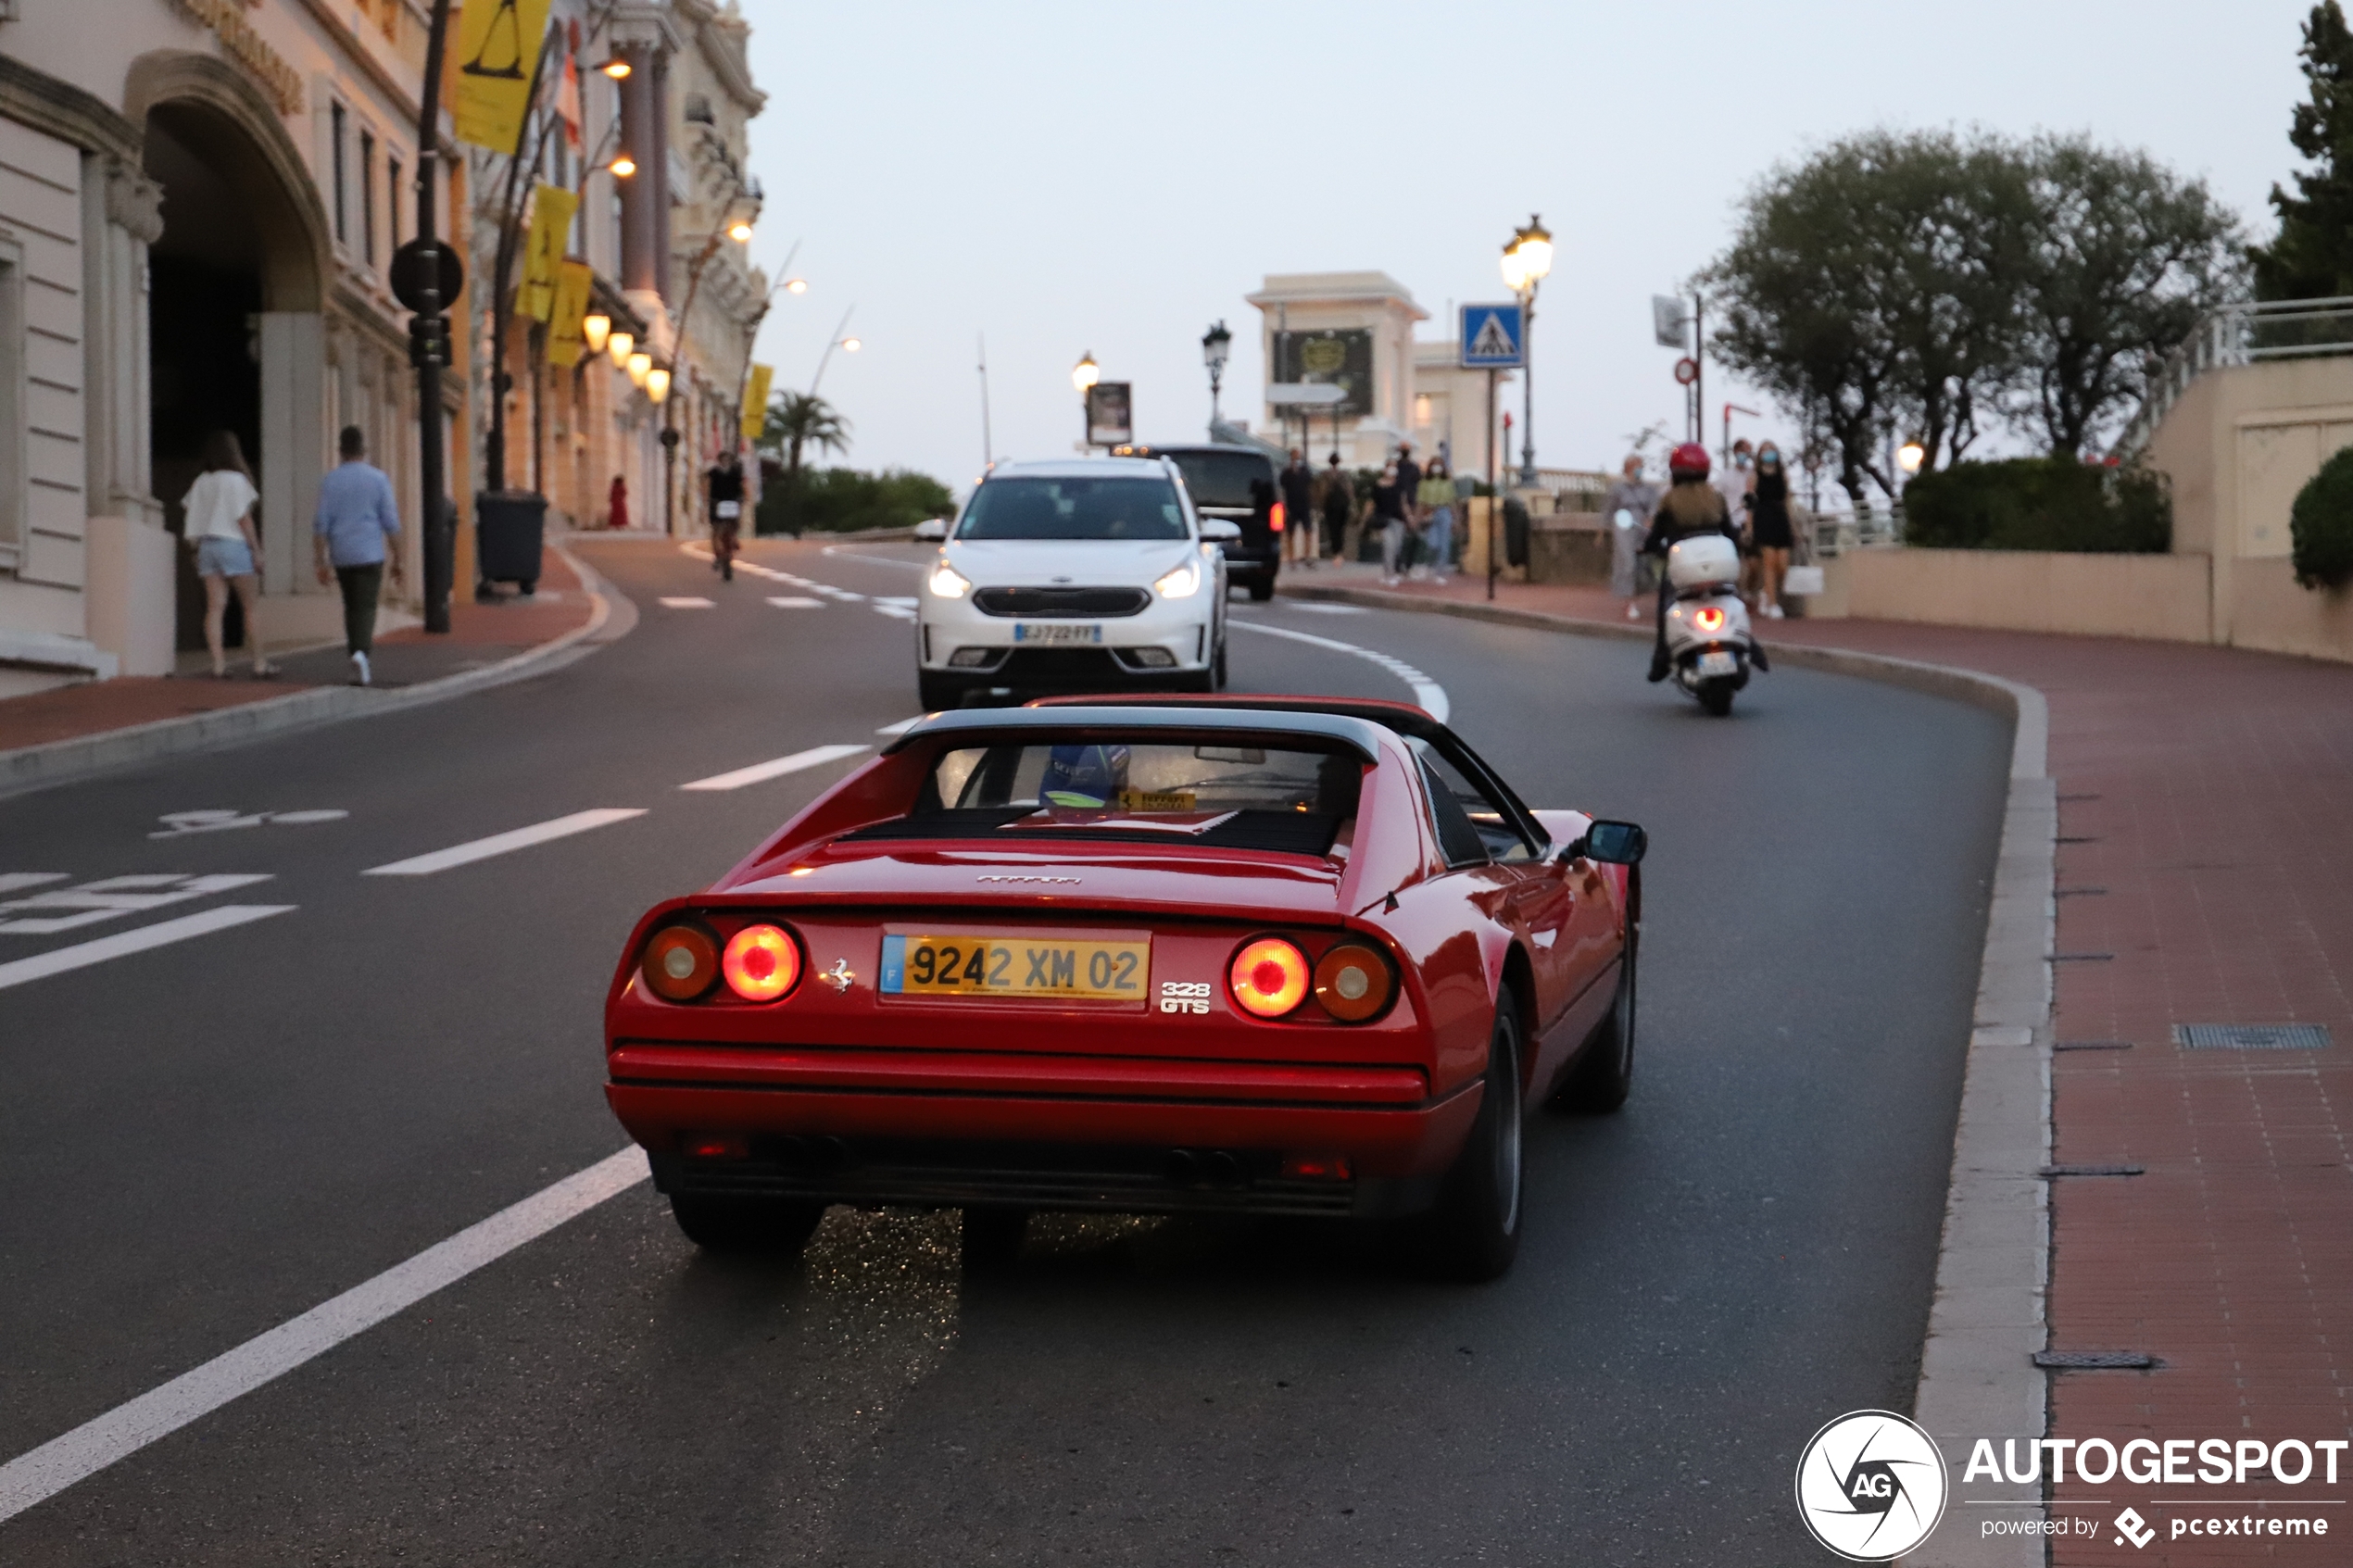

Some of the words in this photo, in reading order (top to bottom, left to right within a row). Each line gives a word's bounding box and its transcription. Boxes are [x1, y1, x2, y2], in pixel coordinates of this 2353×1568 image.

[913, 946, 1013, 986] 9242
[1025, 948, 1076, 988] XM
[1088, 950, 1139, 990] 02
[1162, 982, 1211, 997] 328
[1161, 997, 1210, 1014] GTS
